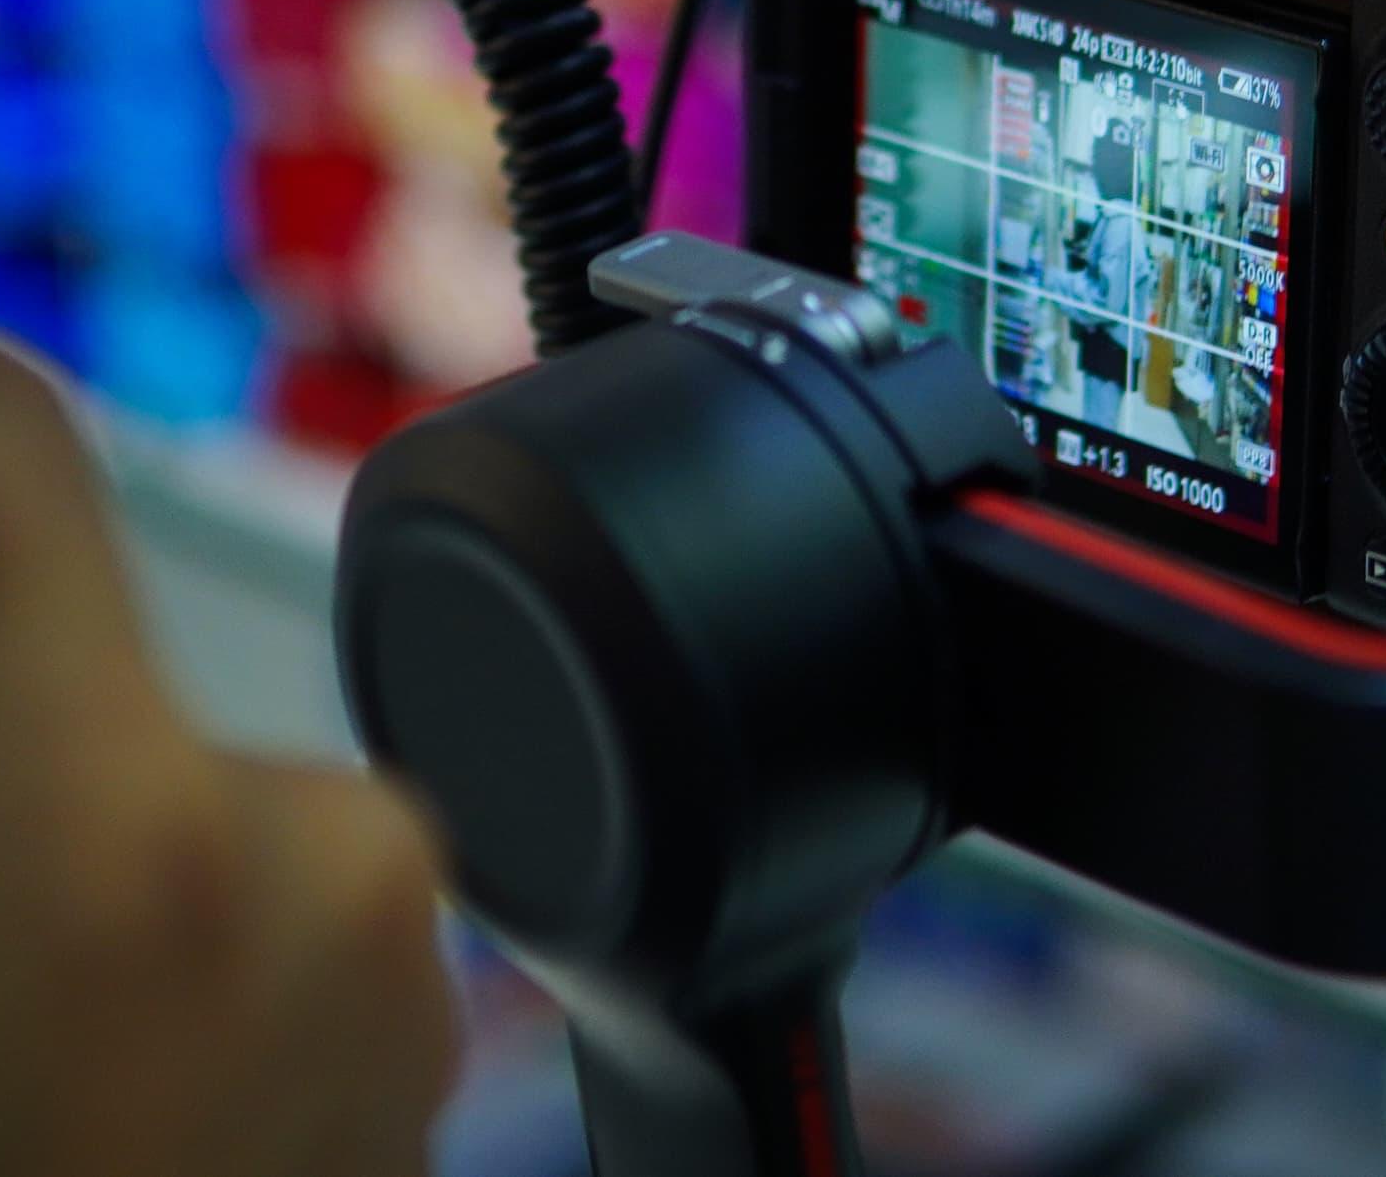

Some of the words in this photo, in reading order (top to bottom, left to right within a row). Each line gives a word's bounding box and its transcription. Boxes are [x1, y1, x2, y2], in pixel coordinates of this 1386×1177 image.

[1072, 25, 1100, 59] 24p
[1252, 77, 1281, 110] 37%
[1194, 142, 1222, 166] Wi-Fi
[1239, 260, 1285, 292] 5000K
[1245, 348, 1273, 375] OFF
[1146, 465, 1177, 497] ISO
[1180, 471, 1226, 515] 1000
